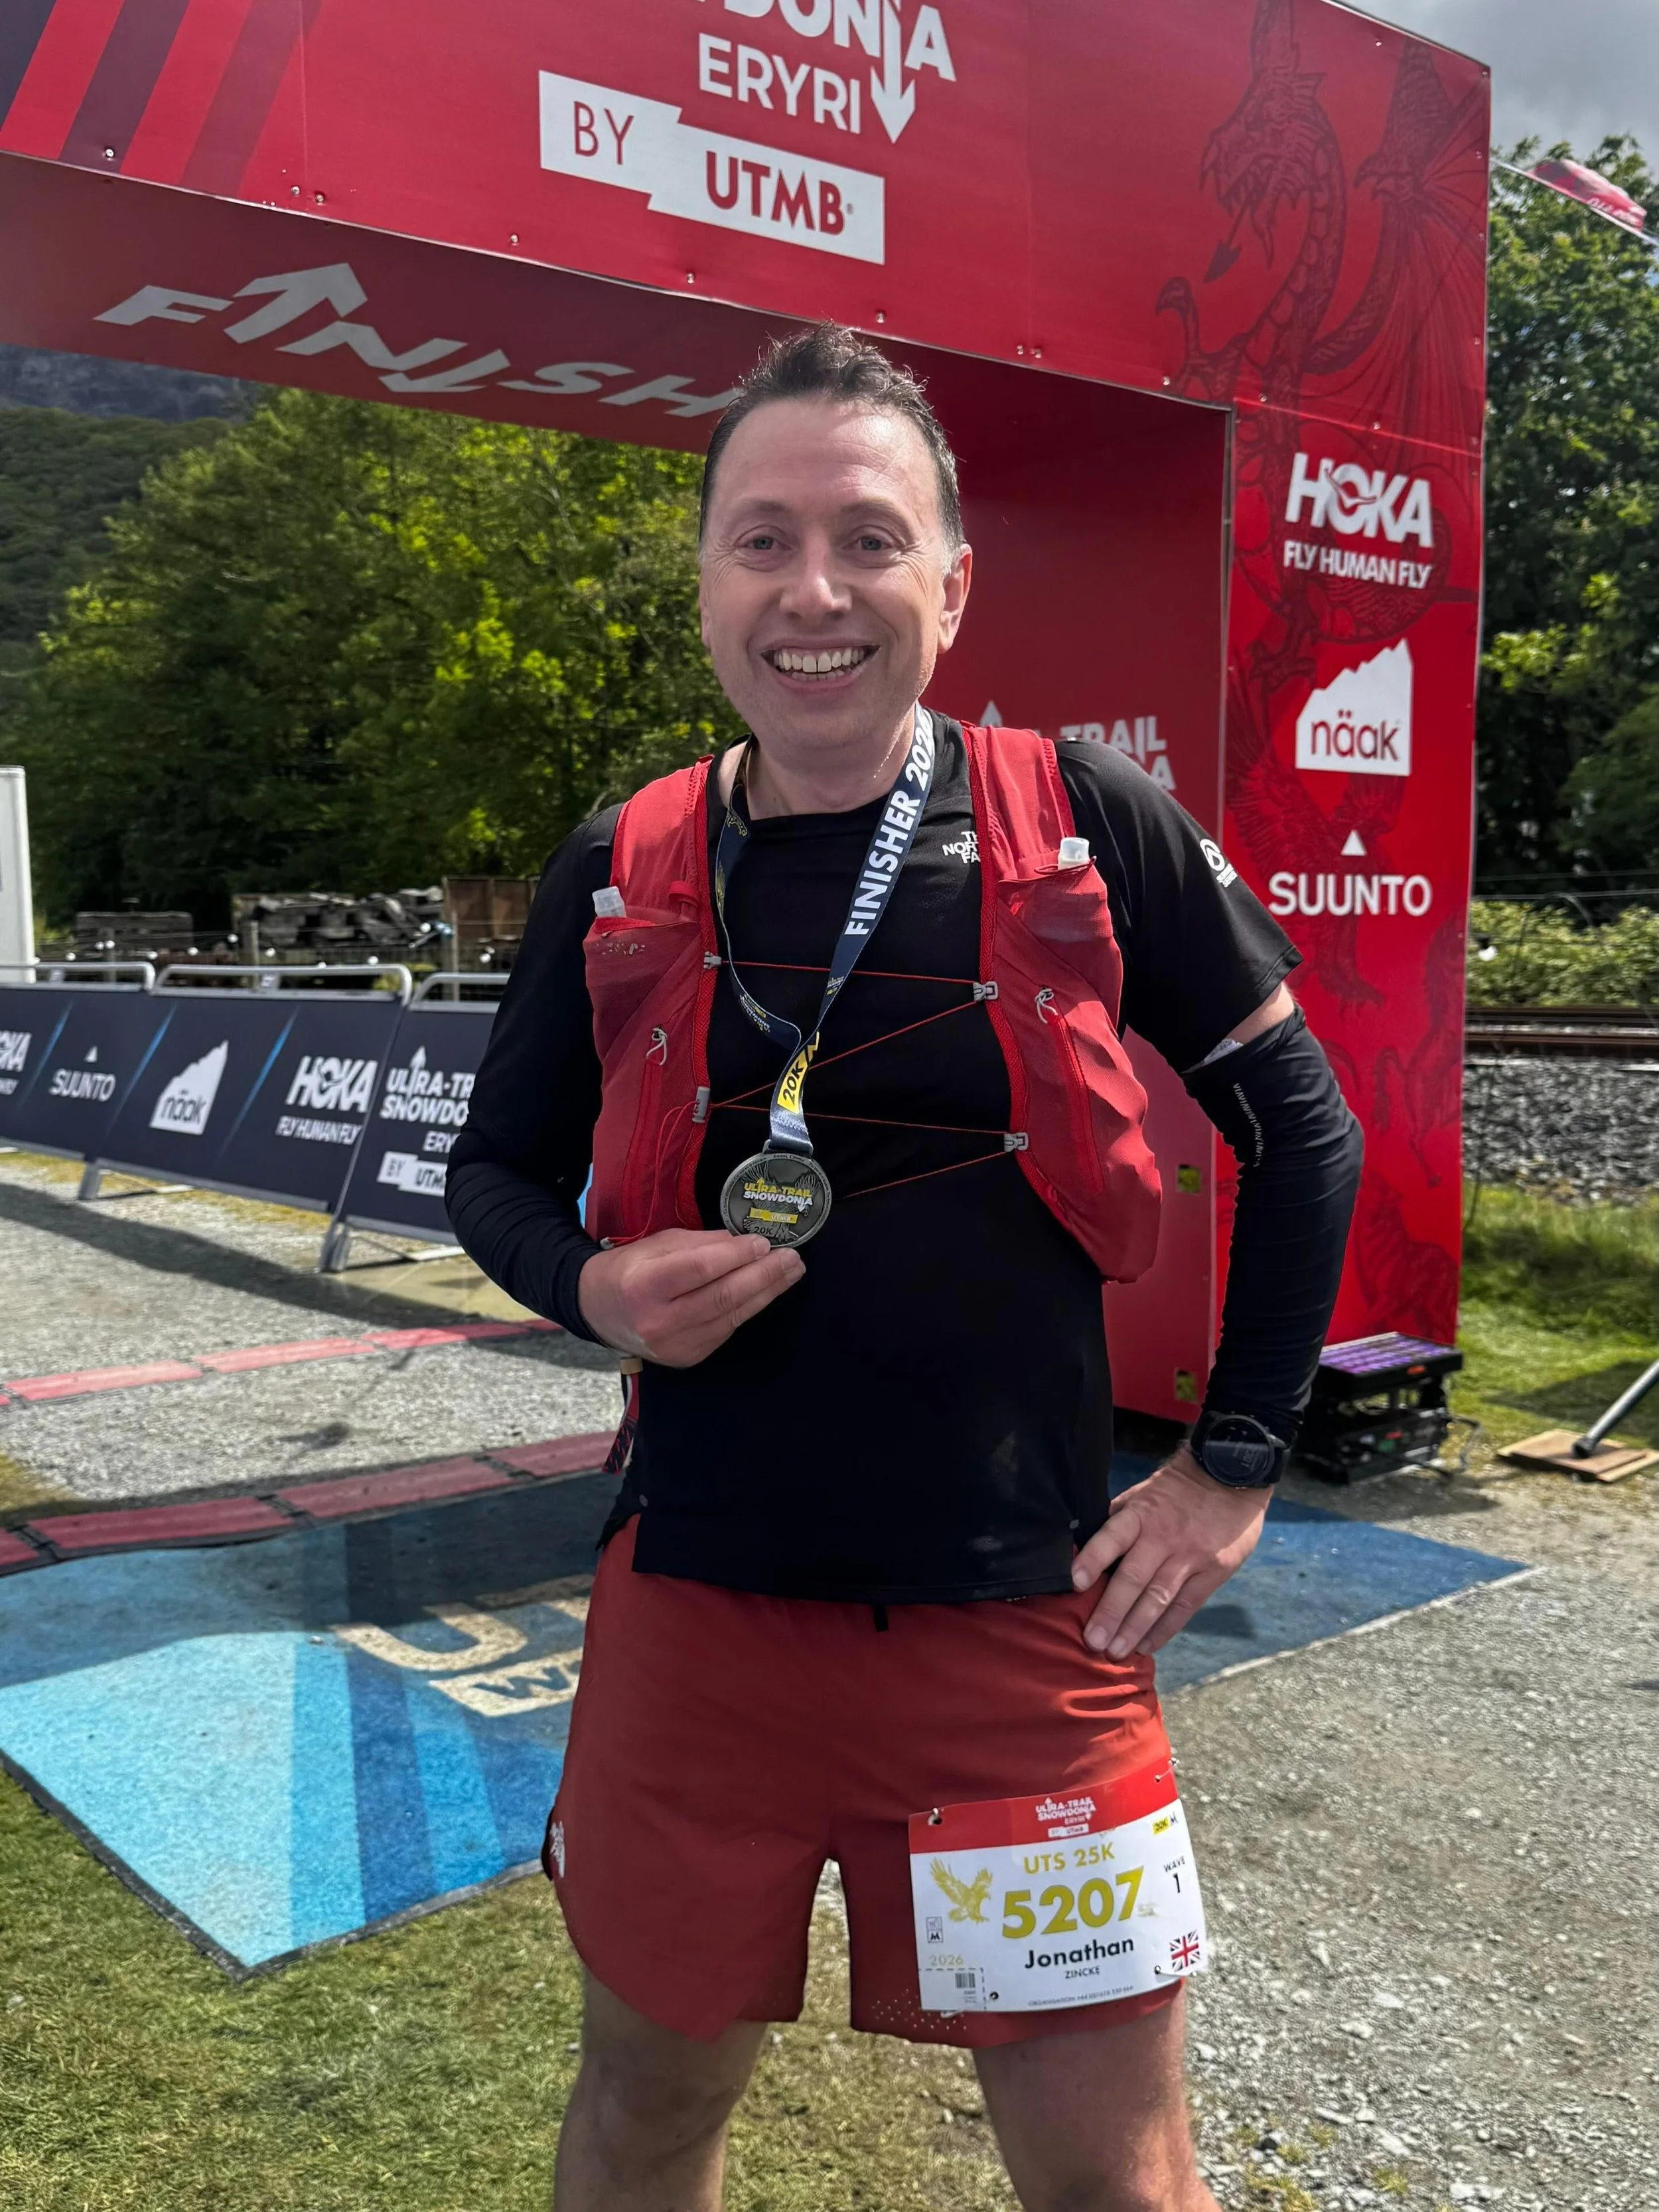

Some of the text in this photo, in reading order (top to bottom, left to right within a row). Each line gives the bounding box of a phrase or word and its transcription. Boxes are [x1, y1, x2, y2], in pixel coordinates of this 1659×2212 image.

[724, 0, 957, 100] ONIA
[699, 33, 861, 134] ERYRI
[573, 100, 635, 165] BY
[1285, 451, 1434, 549] HOKA
[1283, 540, 1433, 589] FLY HUMAN FLY
[1310, 710, 1399, 762] näak
[845, 790, 920, 936] FINISHER
[942, 841, 978, 856] NOR
[960, 850, 981, 863] FA
[1268, 871, 1432, 917] SUUNTO
[48, 1069, 116, 1102] SUUNTO
[285, 1055, 378, 1114] HOKA
[386, 1045, 476, 1100] ULTRA-TR
[782, 1061, 805, 1106] 20K
[380, 1093, 469, 1127] SNOWDO
[423, 1130, 461, 1153] ERY
[415, 1168, 444, 1189] UTM
[743, 1191, 813, 1209] SNOWDONIA
[1024, 1842, 1116, 1874] UTS 25K
[1163, 1856, 1186, 1872] WAVE
[1173, 1872, 1180, 1893] 1
[1002, 1866, 1144, 1939] 5207
[930, 1954, 964, 1966] 2026
[1025, 1937, 1134, 1969] Jonathan
[1065, 1965, 1100, 1979] ZINCKE
